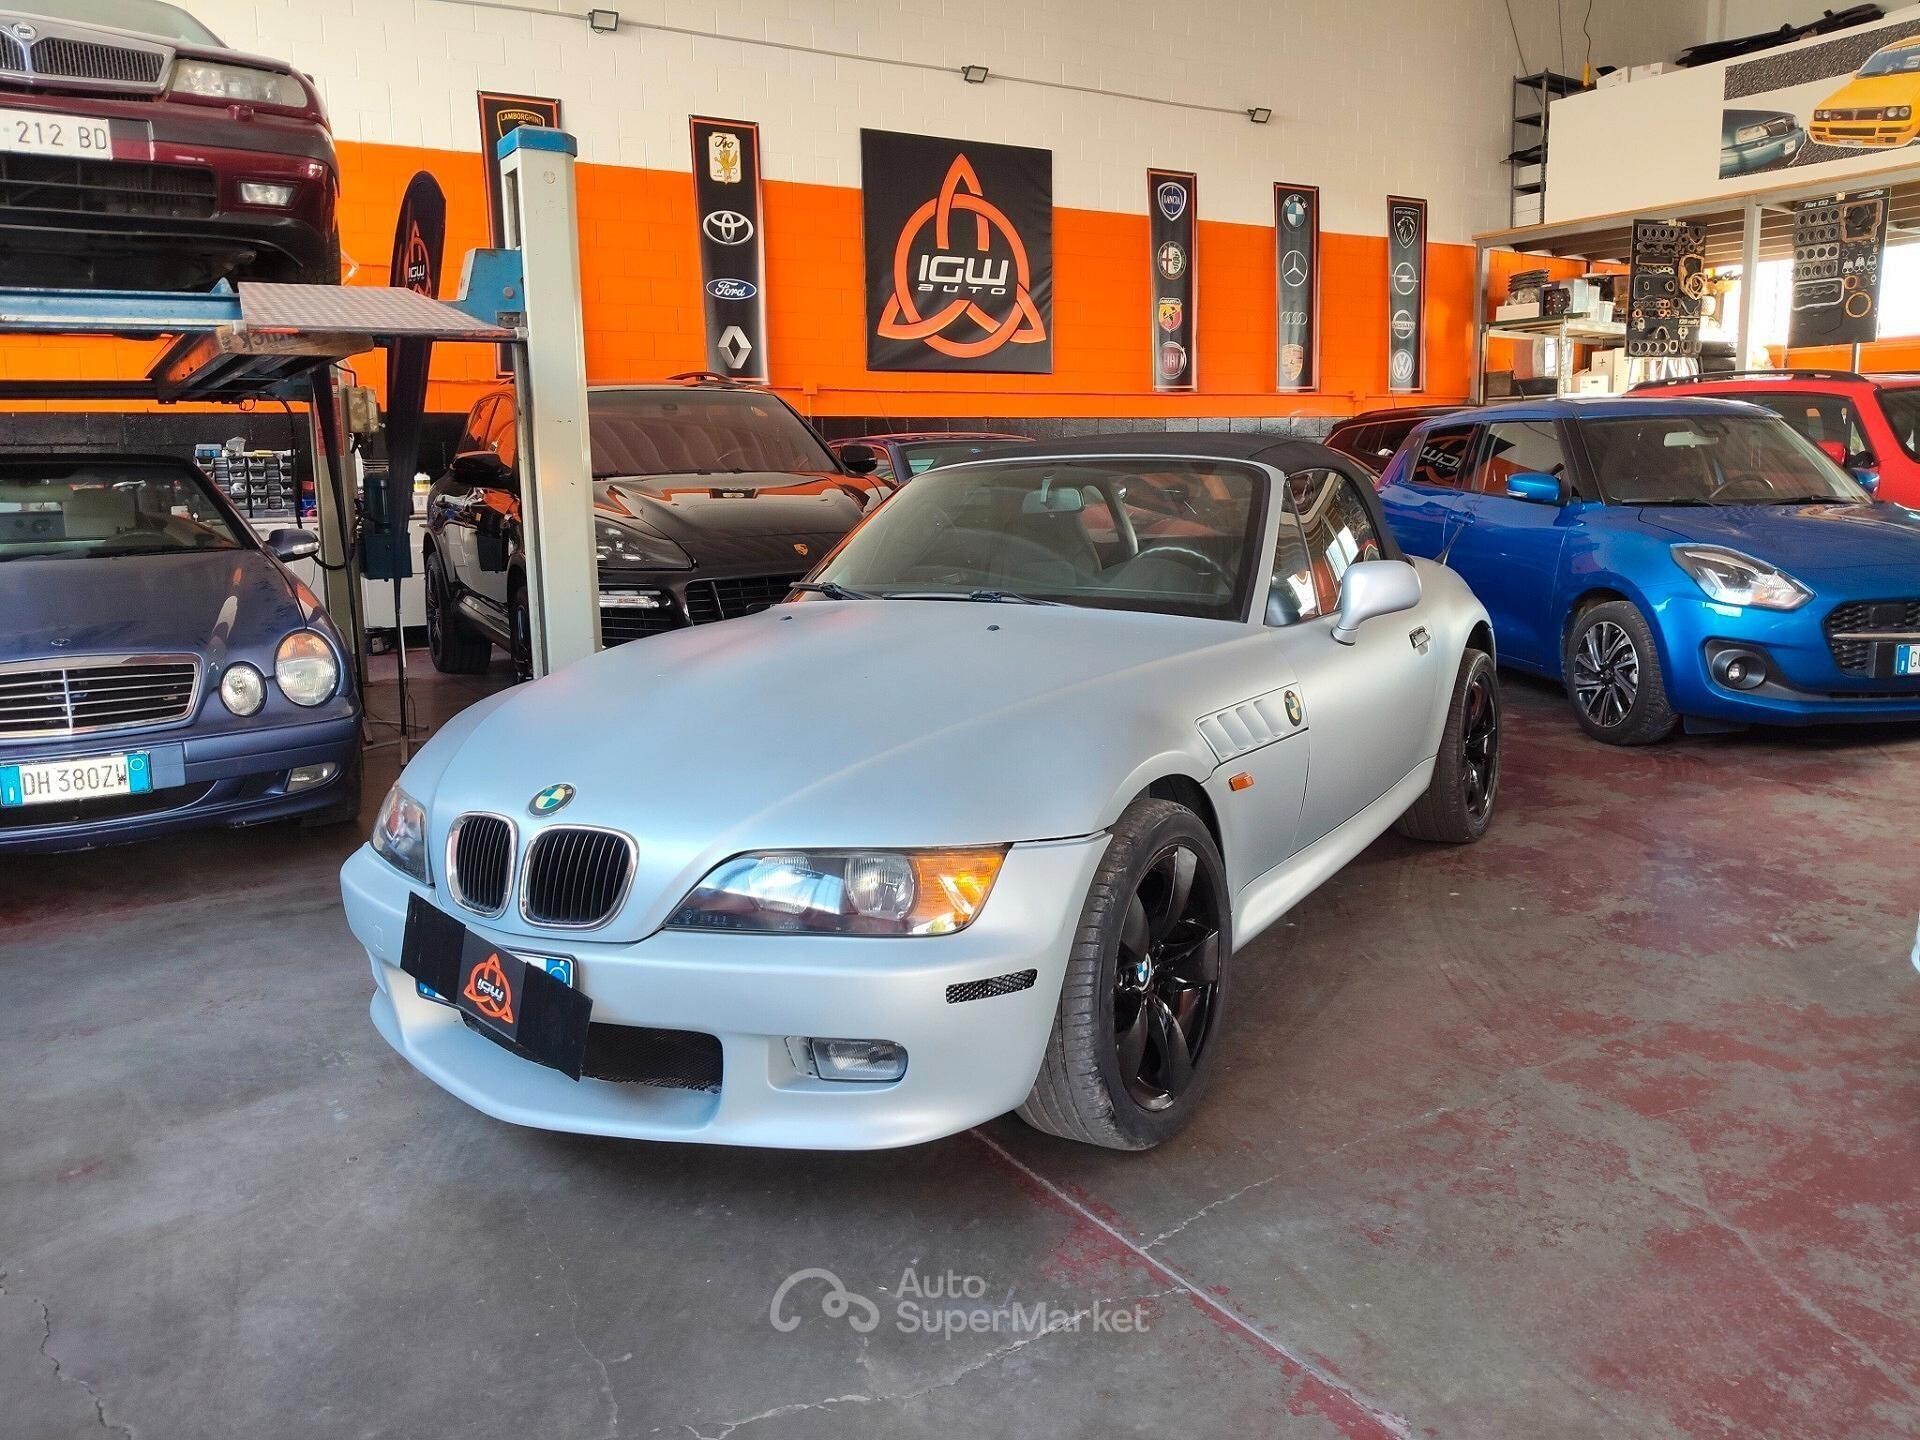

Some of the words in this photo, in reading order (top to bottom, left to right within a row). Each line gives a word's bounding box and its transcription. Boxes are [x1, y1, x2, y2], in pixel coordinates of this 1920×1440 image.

[16, 121, 63, 146] 212
[78, 126, 107, 150] BD
[918, 254, 1010, 286] IGW
[714, 280, 746, 297] Ford
[22, 769, 51, 796] DH
[57, 763, 128, 792] 380ZW
